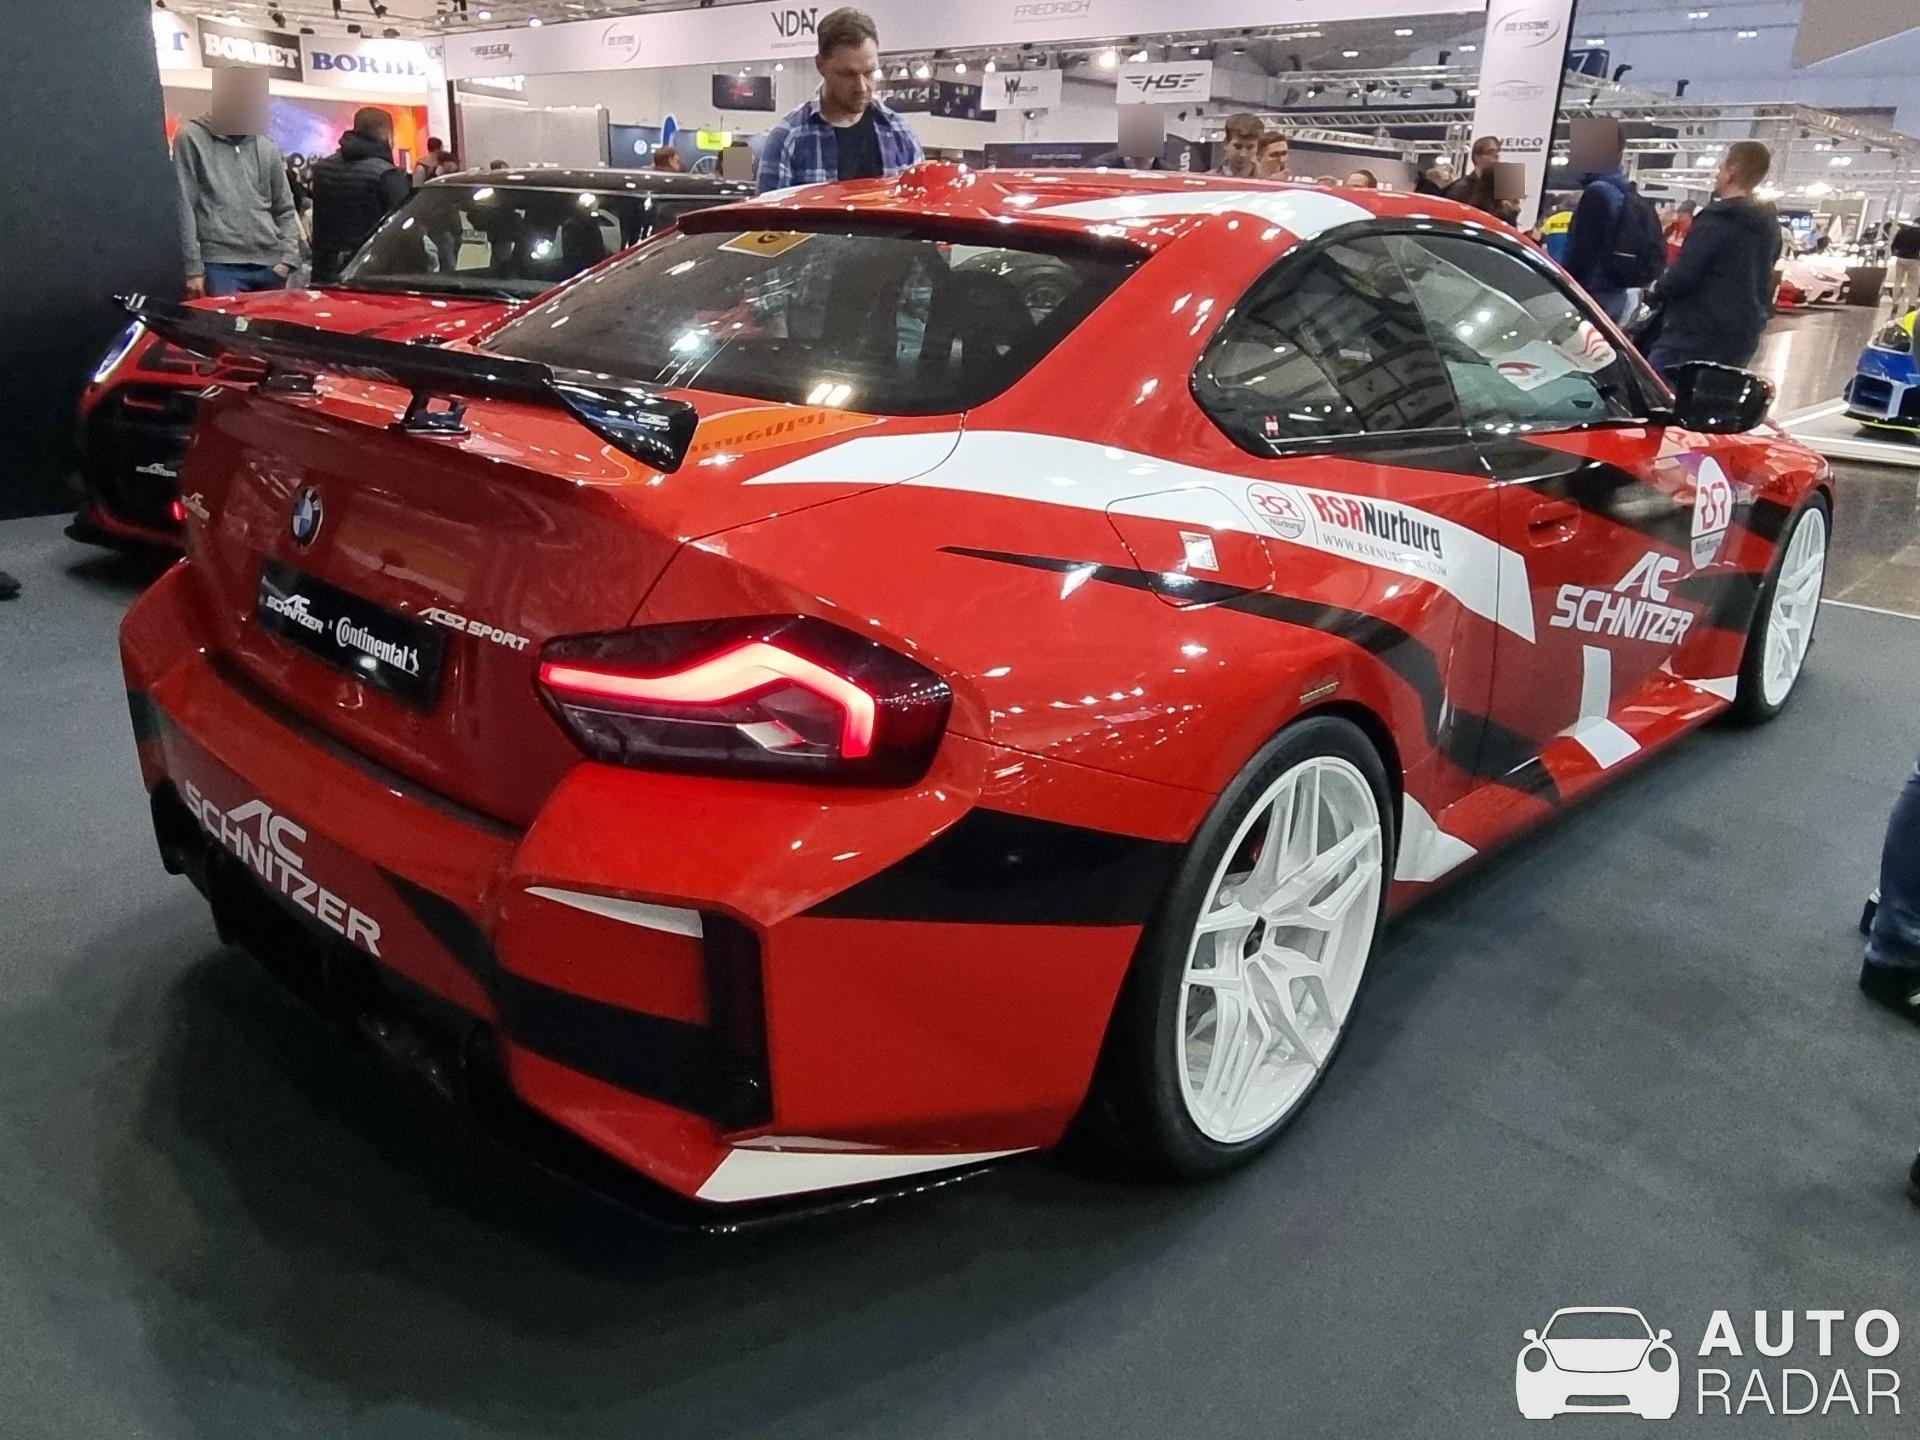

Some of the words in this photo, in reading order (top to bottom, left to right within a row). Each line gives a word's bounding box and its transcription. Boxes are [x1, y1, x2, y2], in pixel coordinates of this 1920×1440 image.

[284, 594, 311, 614] AC
[1613, 551, 1679, 603] AC
[266, 595, 324, 634] SCHNITZER
[336, 617, 409, 670] Continental
[417, 607, 467, 631] ACS2
[467, 621, 530, 651] SPORT
[1549, 584, 1694, 645] SCHNITZER
[227, 799, 307, 870] AC
[186, 779, 381, 957] SCHNITZER
